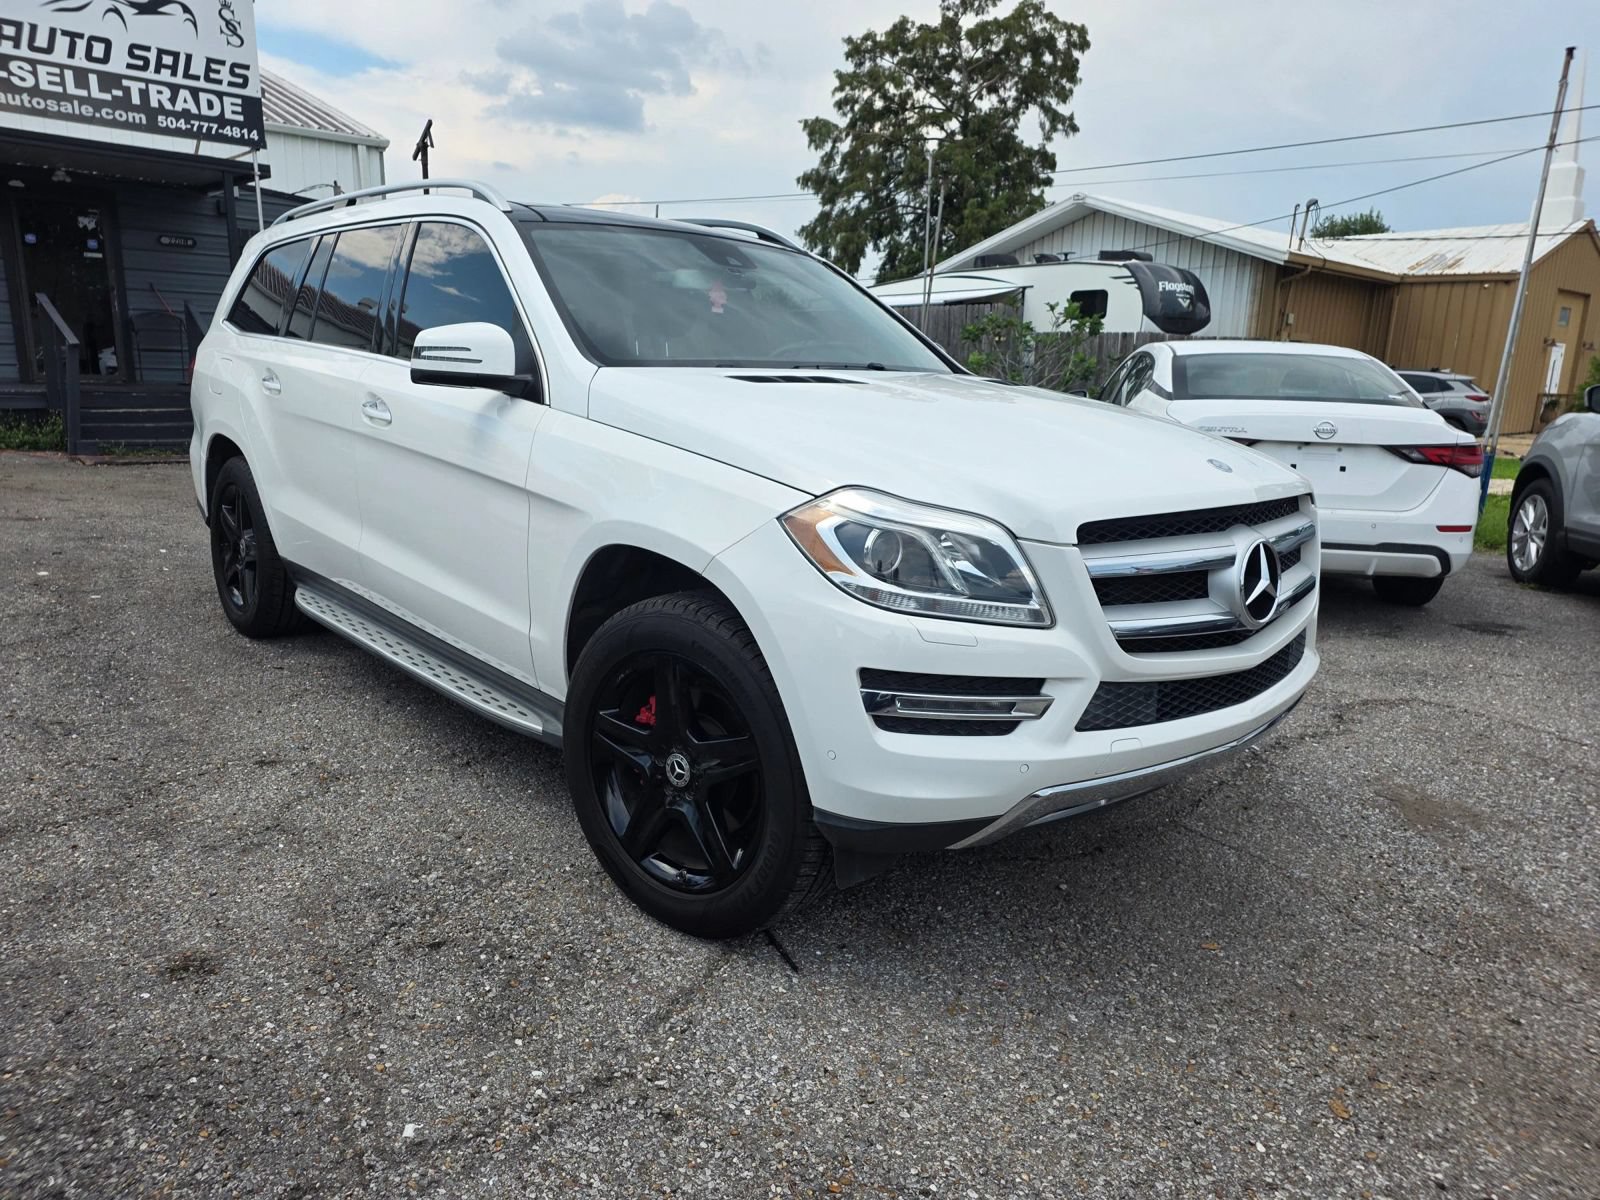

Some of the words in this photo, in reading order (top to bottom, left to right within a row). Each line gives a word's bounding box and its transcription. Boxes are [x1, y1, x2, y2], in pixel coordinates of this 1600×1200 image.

[0, 17, 112, 65] AUTO
[126, 43, 250, 90] SALES
[158, 116, 259, 141] 504-777-4814
